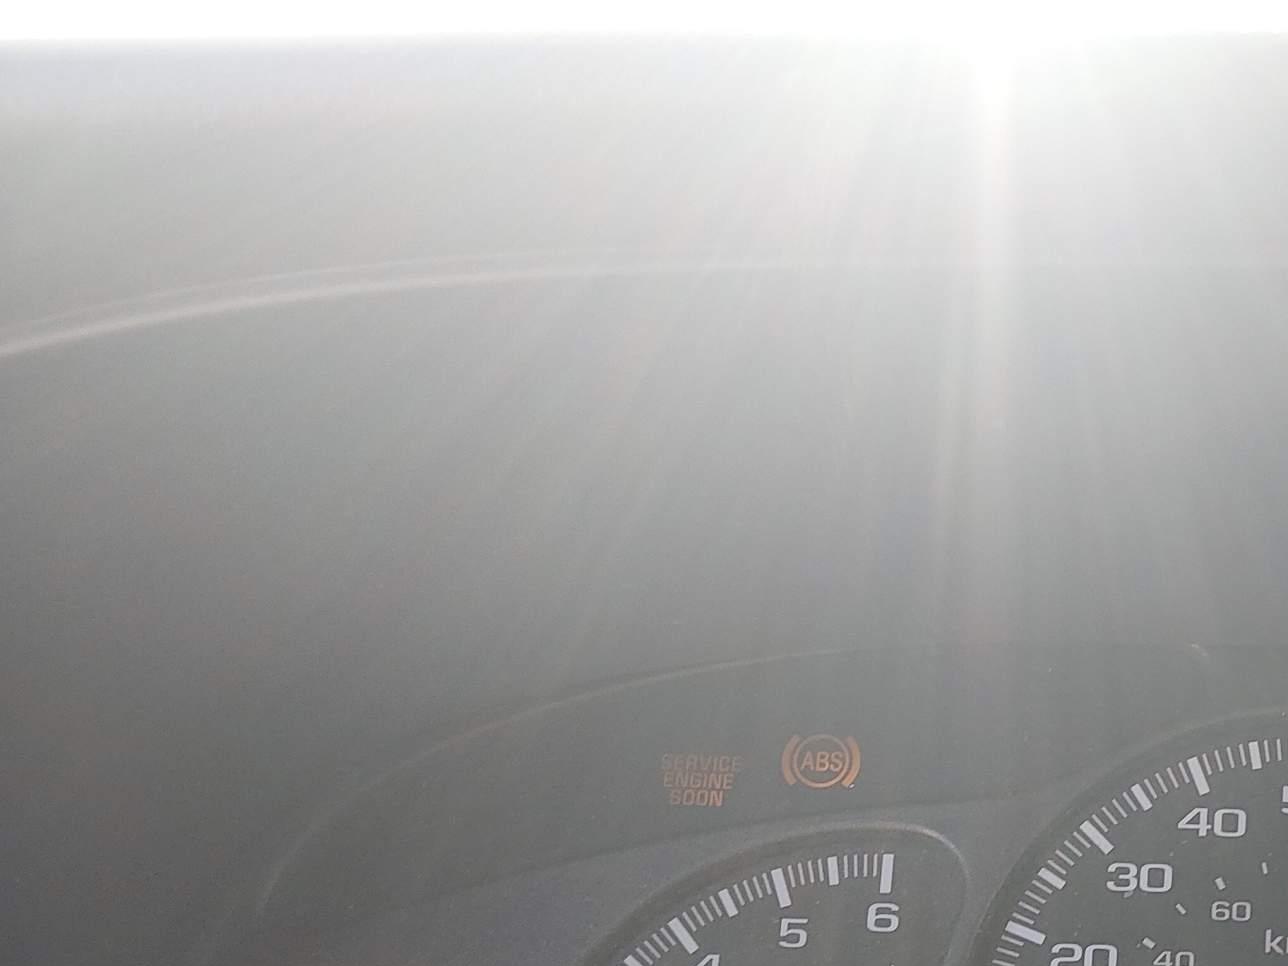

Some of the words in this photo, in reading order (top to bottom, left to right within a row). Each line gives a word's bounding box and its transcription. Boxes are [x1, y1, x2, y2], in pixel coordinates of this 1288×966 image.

[662, 753, 742, 772] SERVICE
[800, 751, 844, 772] ABS
[663, 772, 734, 789] ENGINE
[670, 790, 724, 806] SOON
[1177, 808, 1247, 837] 40
[1106, 863, 1173, 893] 30
[867, 903, 899, 932] 6
[1211, 901, 1252, 922] 60
[778, 918, 809, 948] 5
